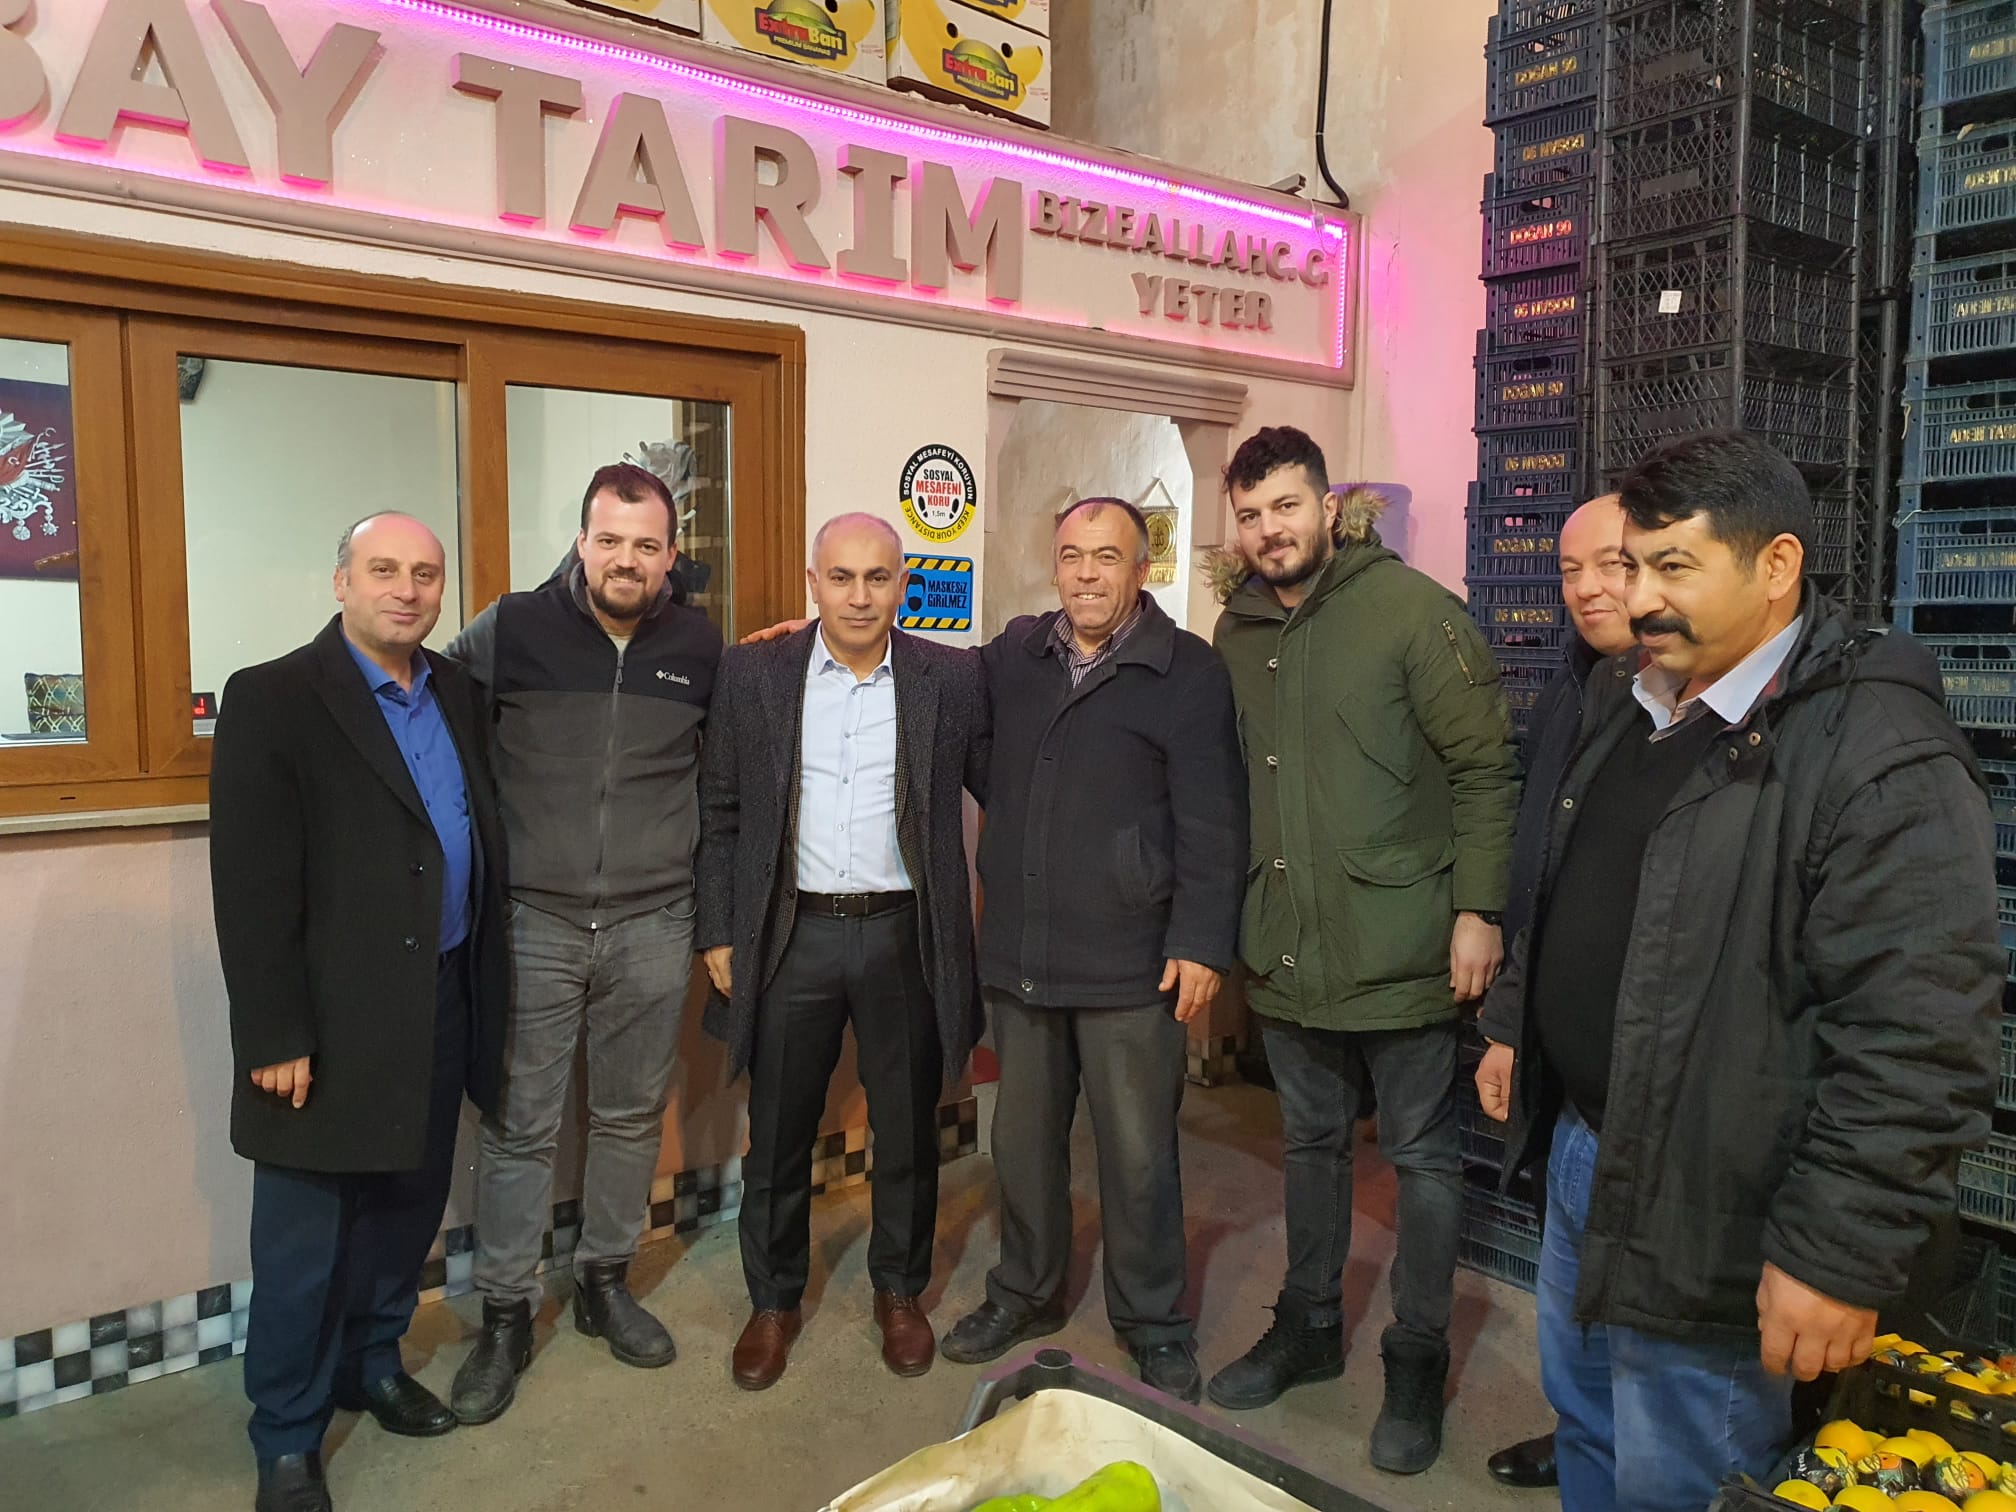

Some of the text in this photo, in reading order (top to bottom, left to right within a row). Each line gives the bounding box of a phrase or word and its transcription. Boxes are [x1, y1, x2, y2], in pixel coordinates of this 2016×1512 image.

[451, 51, 1023, 304] TARIM
[1556, 220, 1572, 236] 90
[1131, 272, 1273, 331] YETER
[903, 460, 919, 496] SOSYAL
[953, 457, 974, 500] KORUYUN
[923, 468, 954, 482] SOSYAL
[915, 479, 962, 496] MESAFENİ
[927, 494, 950, 507] KORU
[904, 505, 970, 540] KEEP YOUR DISTANCE
[664, 671, 690, 686] Columbia
